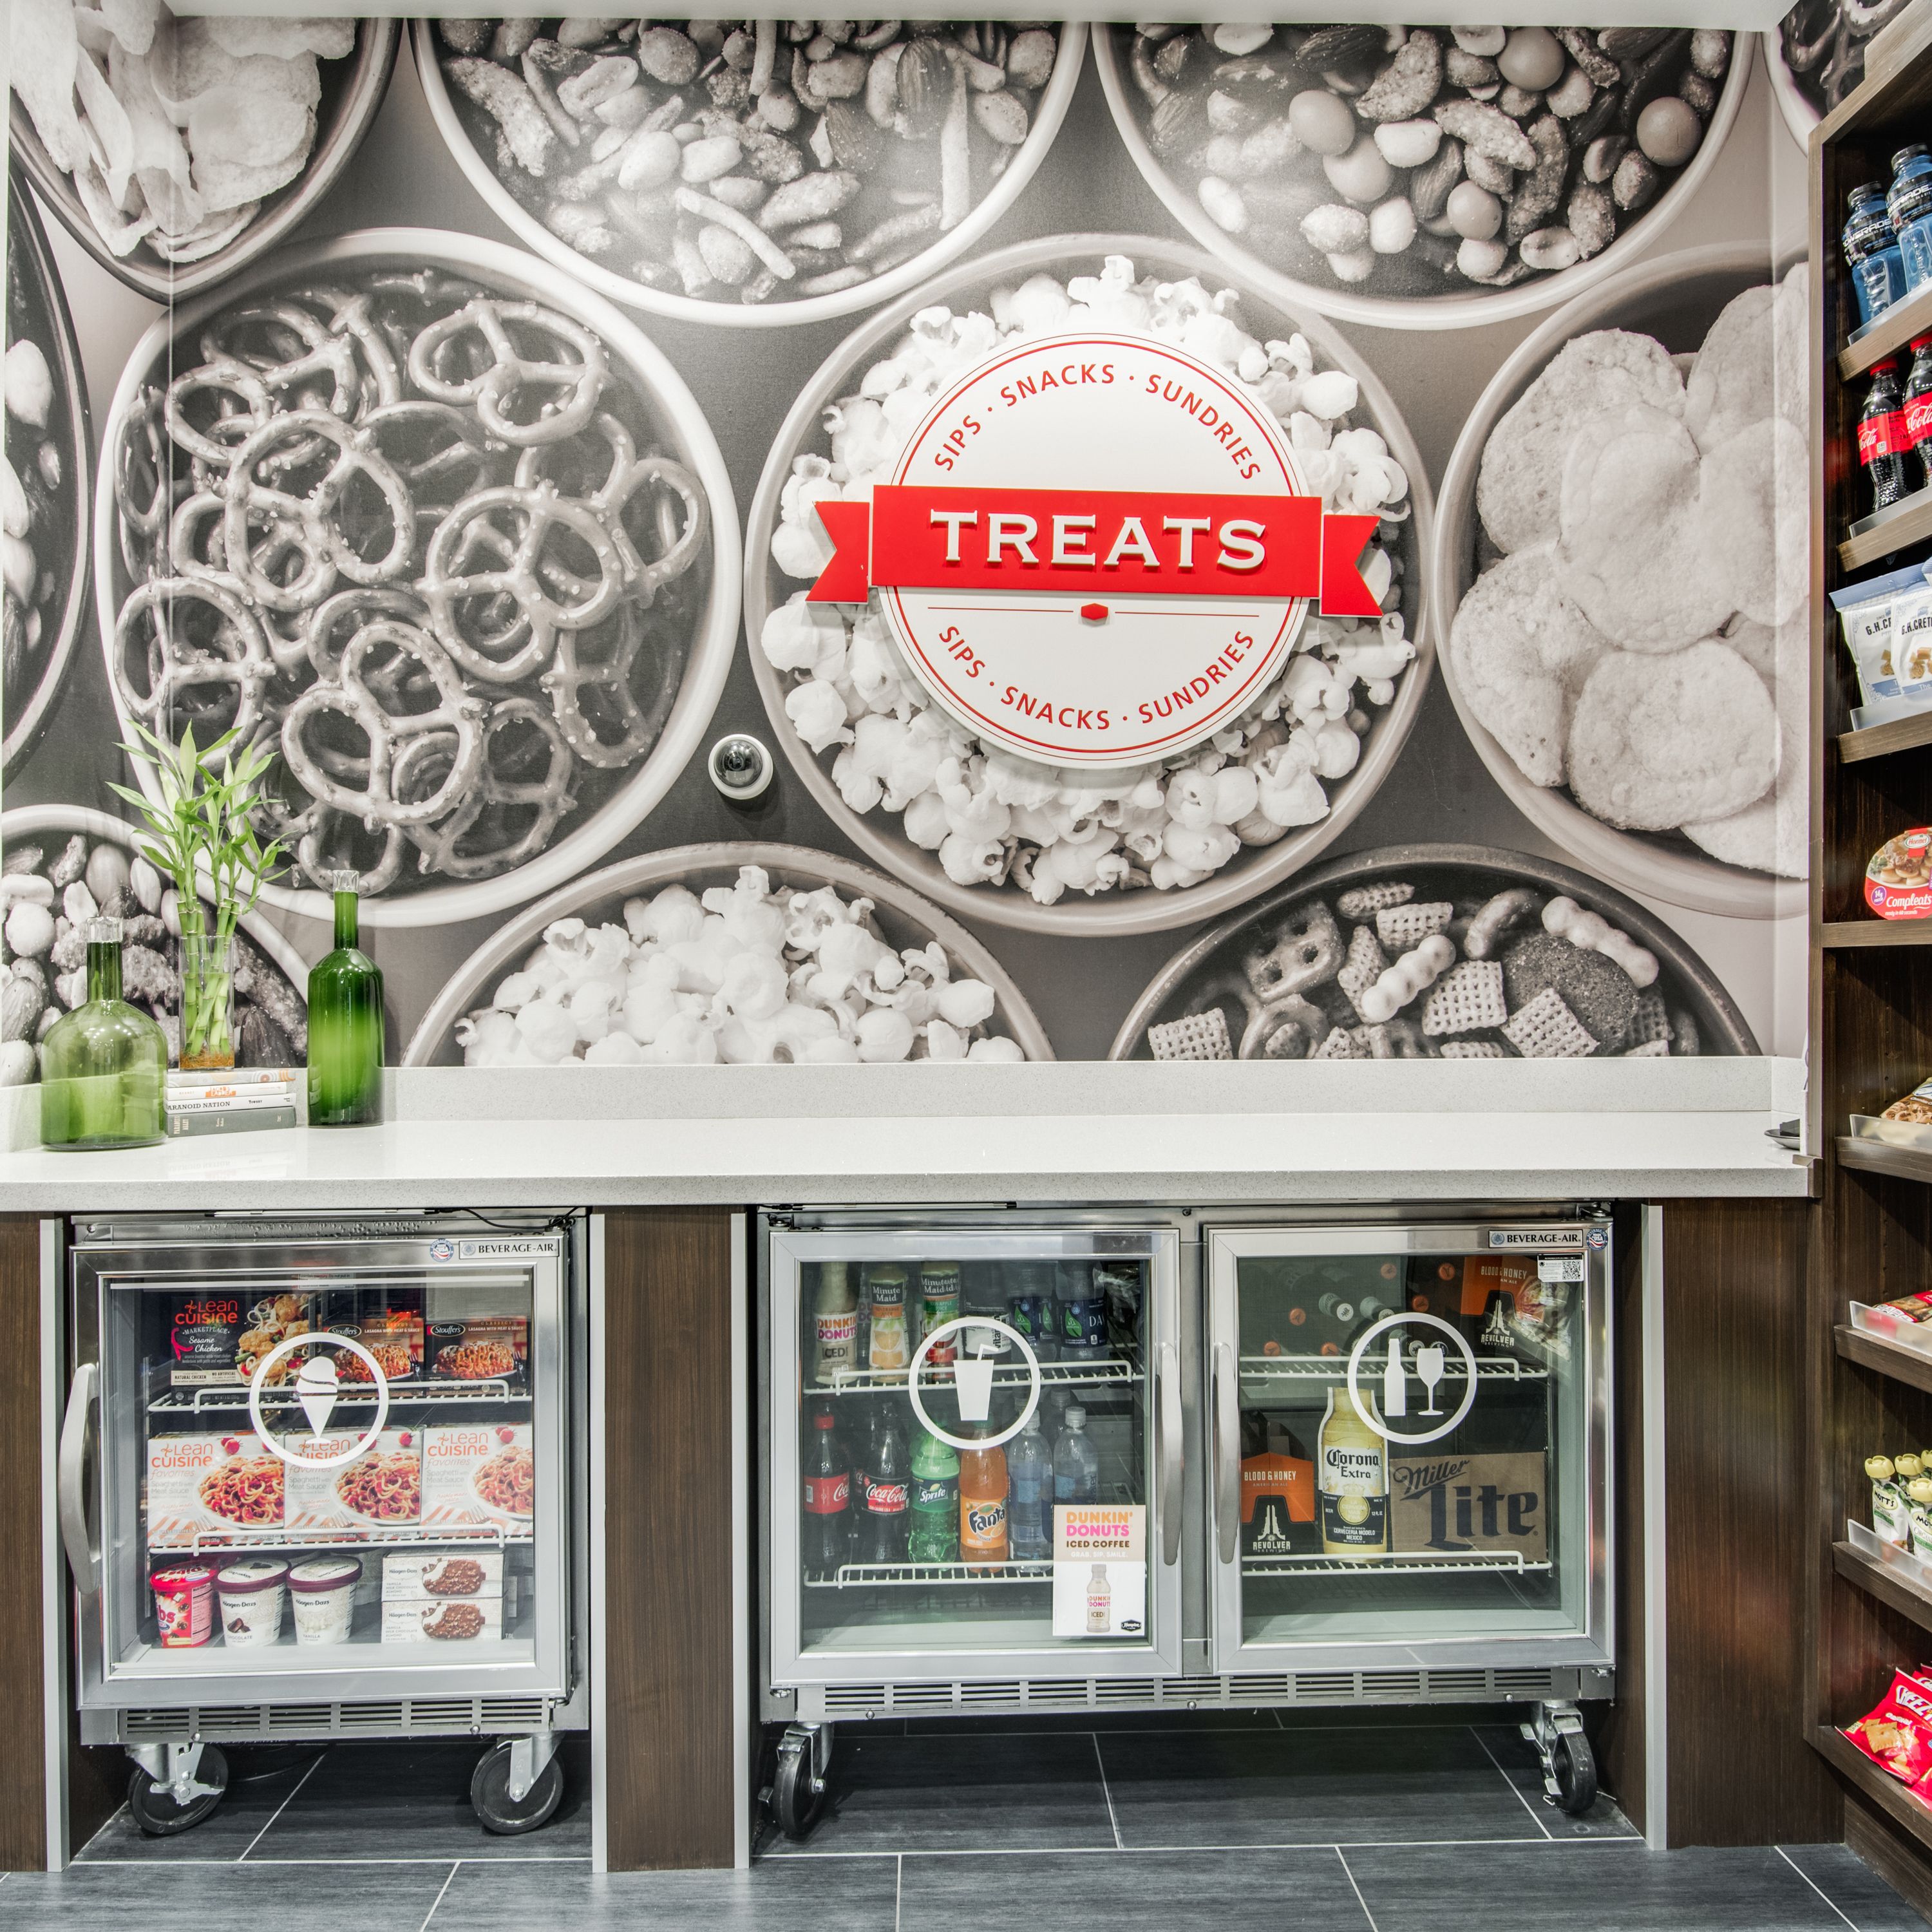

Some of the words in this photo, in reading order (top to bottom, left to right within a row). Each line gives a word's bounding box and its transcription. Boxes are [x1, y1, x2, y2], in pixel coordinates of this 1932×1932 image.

[934, 415, 981, 471] SIPS
[1001, 364, 1115, 406] SNACKS
[1146, 374, 1261, 481] SUNDRIES
[930, 509, 1266, 569] TREATS
[939, 625, 985, 678] SIPS
[1001, 686, 1110, 730] SNACKS
[1139, 630, 1255, 724] SUNDRIES
[1886, 893, 1932, 910] Compleats
[1507, 1234, 1578, 1243] BEVERAGE-AIR
[478, 1244, 554, 1253] BEVERAGE-AIR
[1481, 1265, 1498, 1276] BLOOD
[1503, 1267, 1528, 1280] HONEY
[876, 1294, 897, 1302] Maid
[198, 1300, 238, 1312] Lean
[434, 1325, 461, 1334] Stouffer's
[189, 1336, 215, 1344] Sesame
[1481, 1334, 1515, 1347] REVOLVER
[194, 1344, 223, 1352] Chicken
[451, 1432, 488, 1444] Lean
[174, 1443, 213, 1455] Lean
[425, 1458, 471, 1470] favorites
[1327, 1449, 1379, 1468] Corona
[150, 1469, 194, 1481] favorites
[1244, 1471, 1266, 1481] BLOOD
[1267, 1471, 1273, 1481] &
[1274, 1471, 1296, 1481] HONEY
[1341, 1466, 1371, 1479] Extra
[1393, 1459, 1471, 1495] Miller
[920, 1488, 946, 1503] Sprite
[969, 1507, 1005, 1533] Fanta
[1066, 1511, 1133, 1524] DUNKIN'
[1399, 1484, 1539, 1551] Lite
[1066, 1524, 1130, 1537] DONUTS
[1253, 1541, 1291, 1551] REVOLVER
